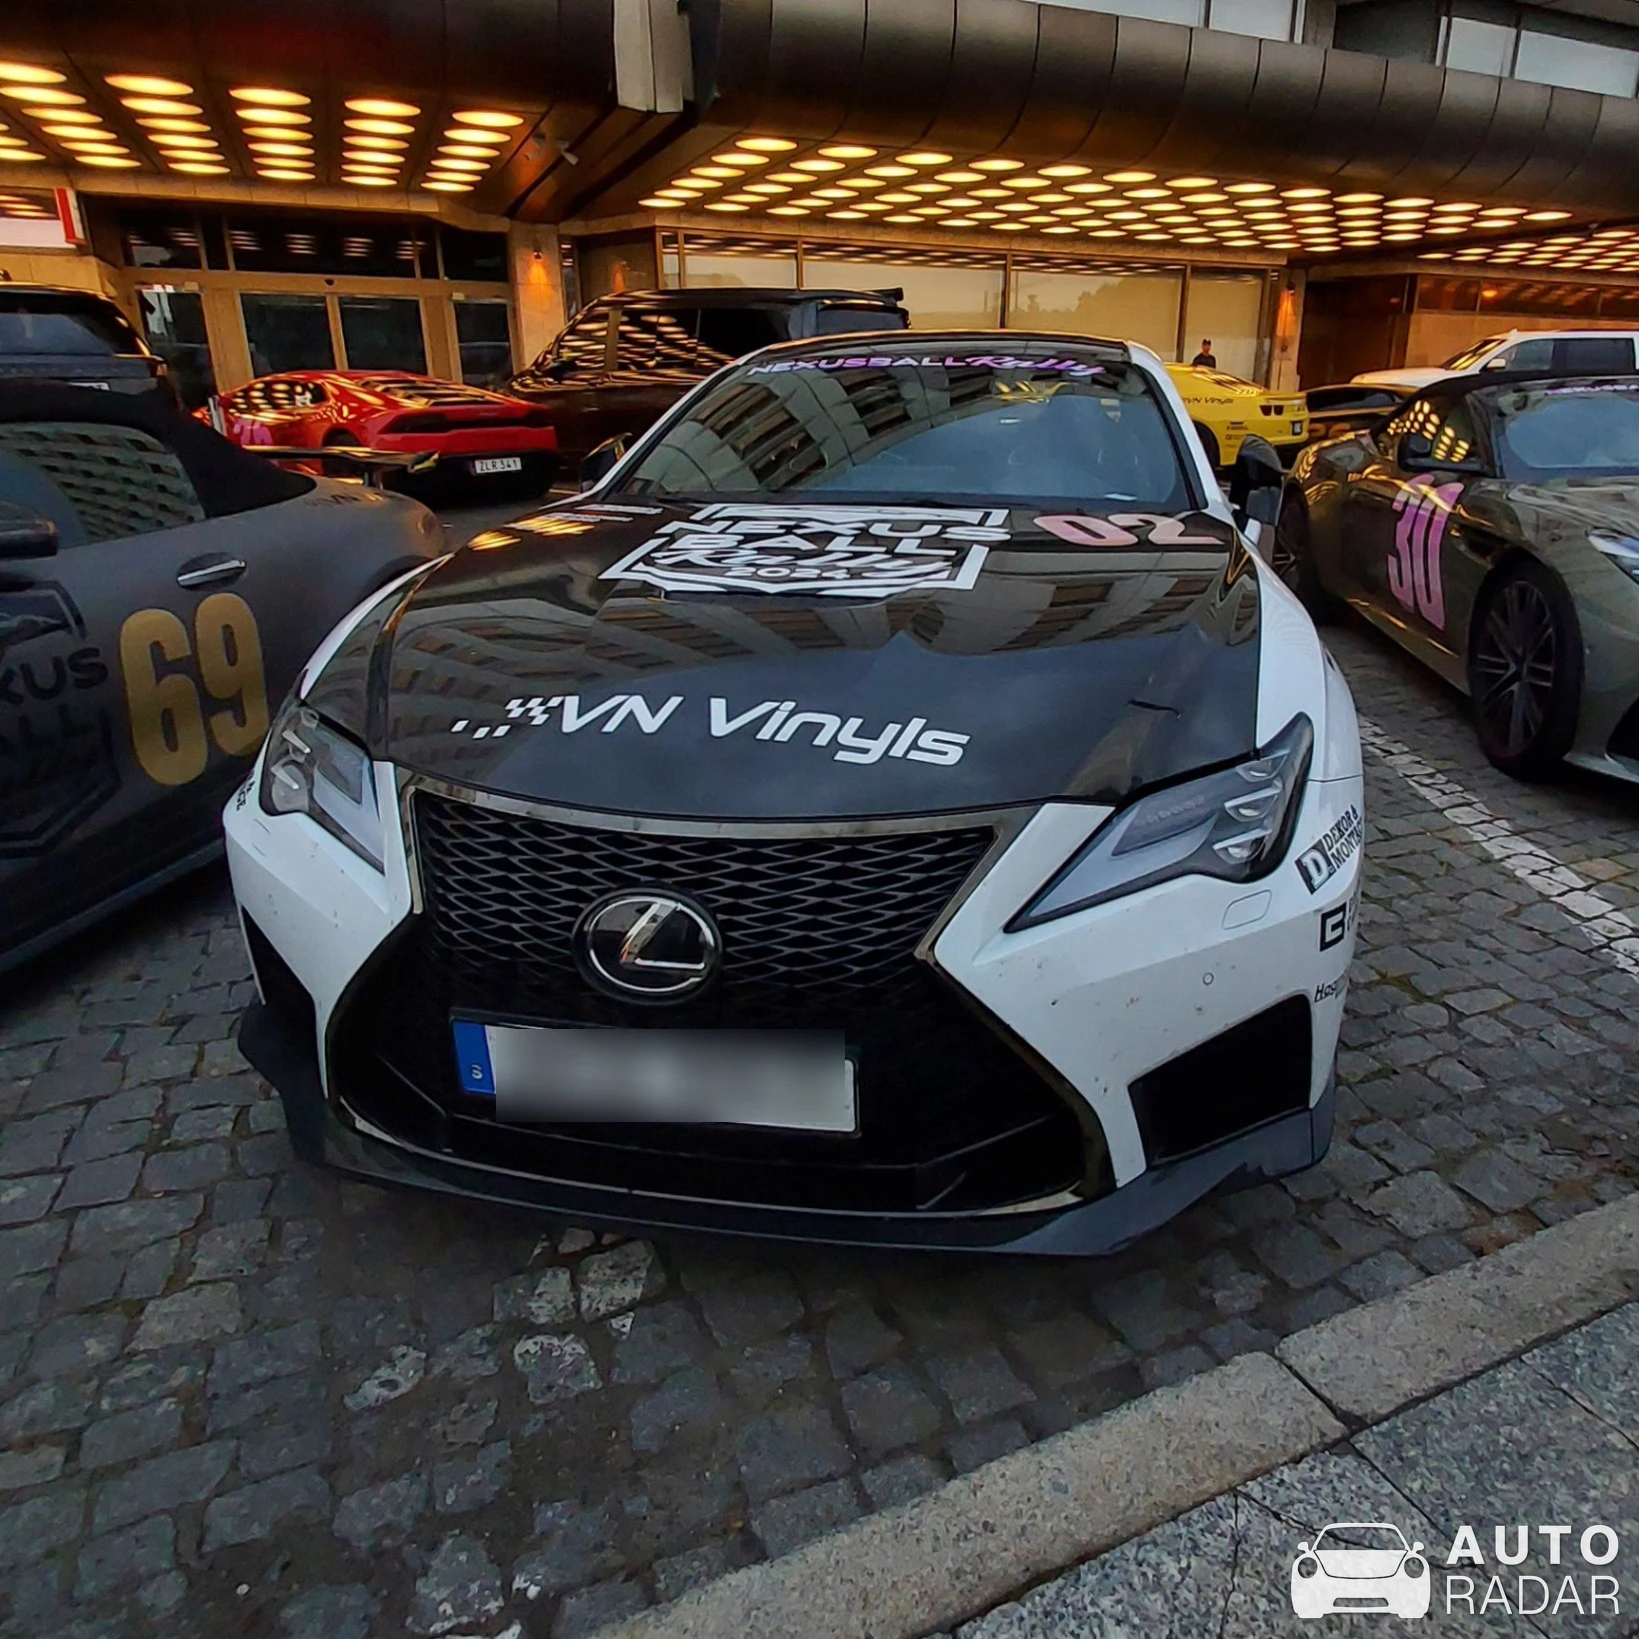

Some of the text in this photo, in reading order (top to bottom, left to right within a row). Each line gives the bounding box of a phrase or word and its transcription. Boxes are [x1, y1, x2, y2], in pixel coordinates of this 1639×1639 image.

[655, 520, 1011, 542] NEXUS
[669, 533, 957, 555] BALL
[1033, 513, 1225, 547] 02
[650, 549, 954, 579] Rally
[1388, 473, 1465, 631] 30
[724, 566, 852, 579] 2024
[120, 593, 269, 786] 69
[559, 695, 971, 766] VN Vinyls
[1322, 810, 1354, 852] DEKOR
